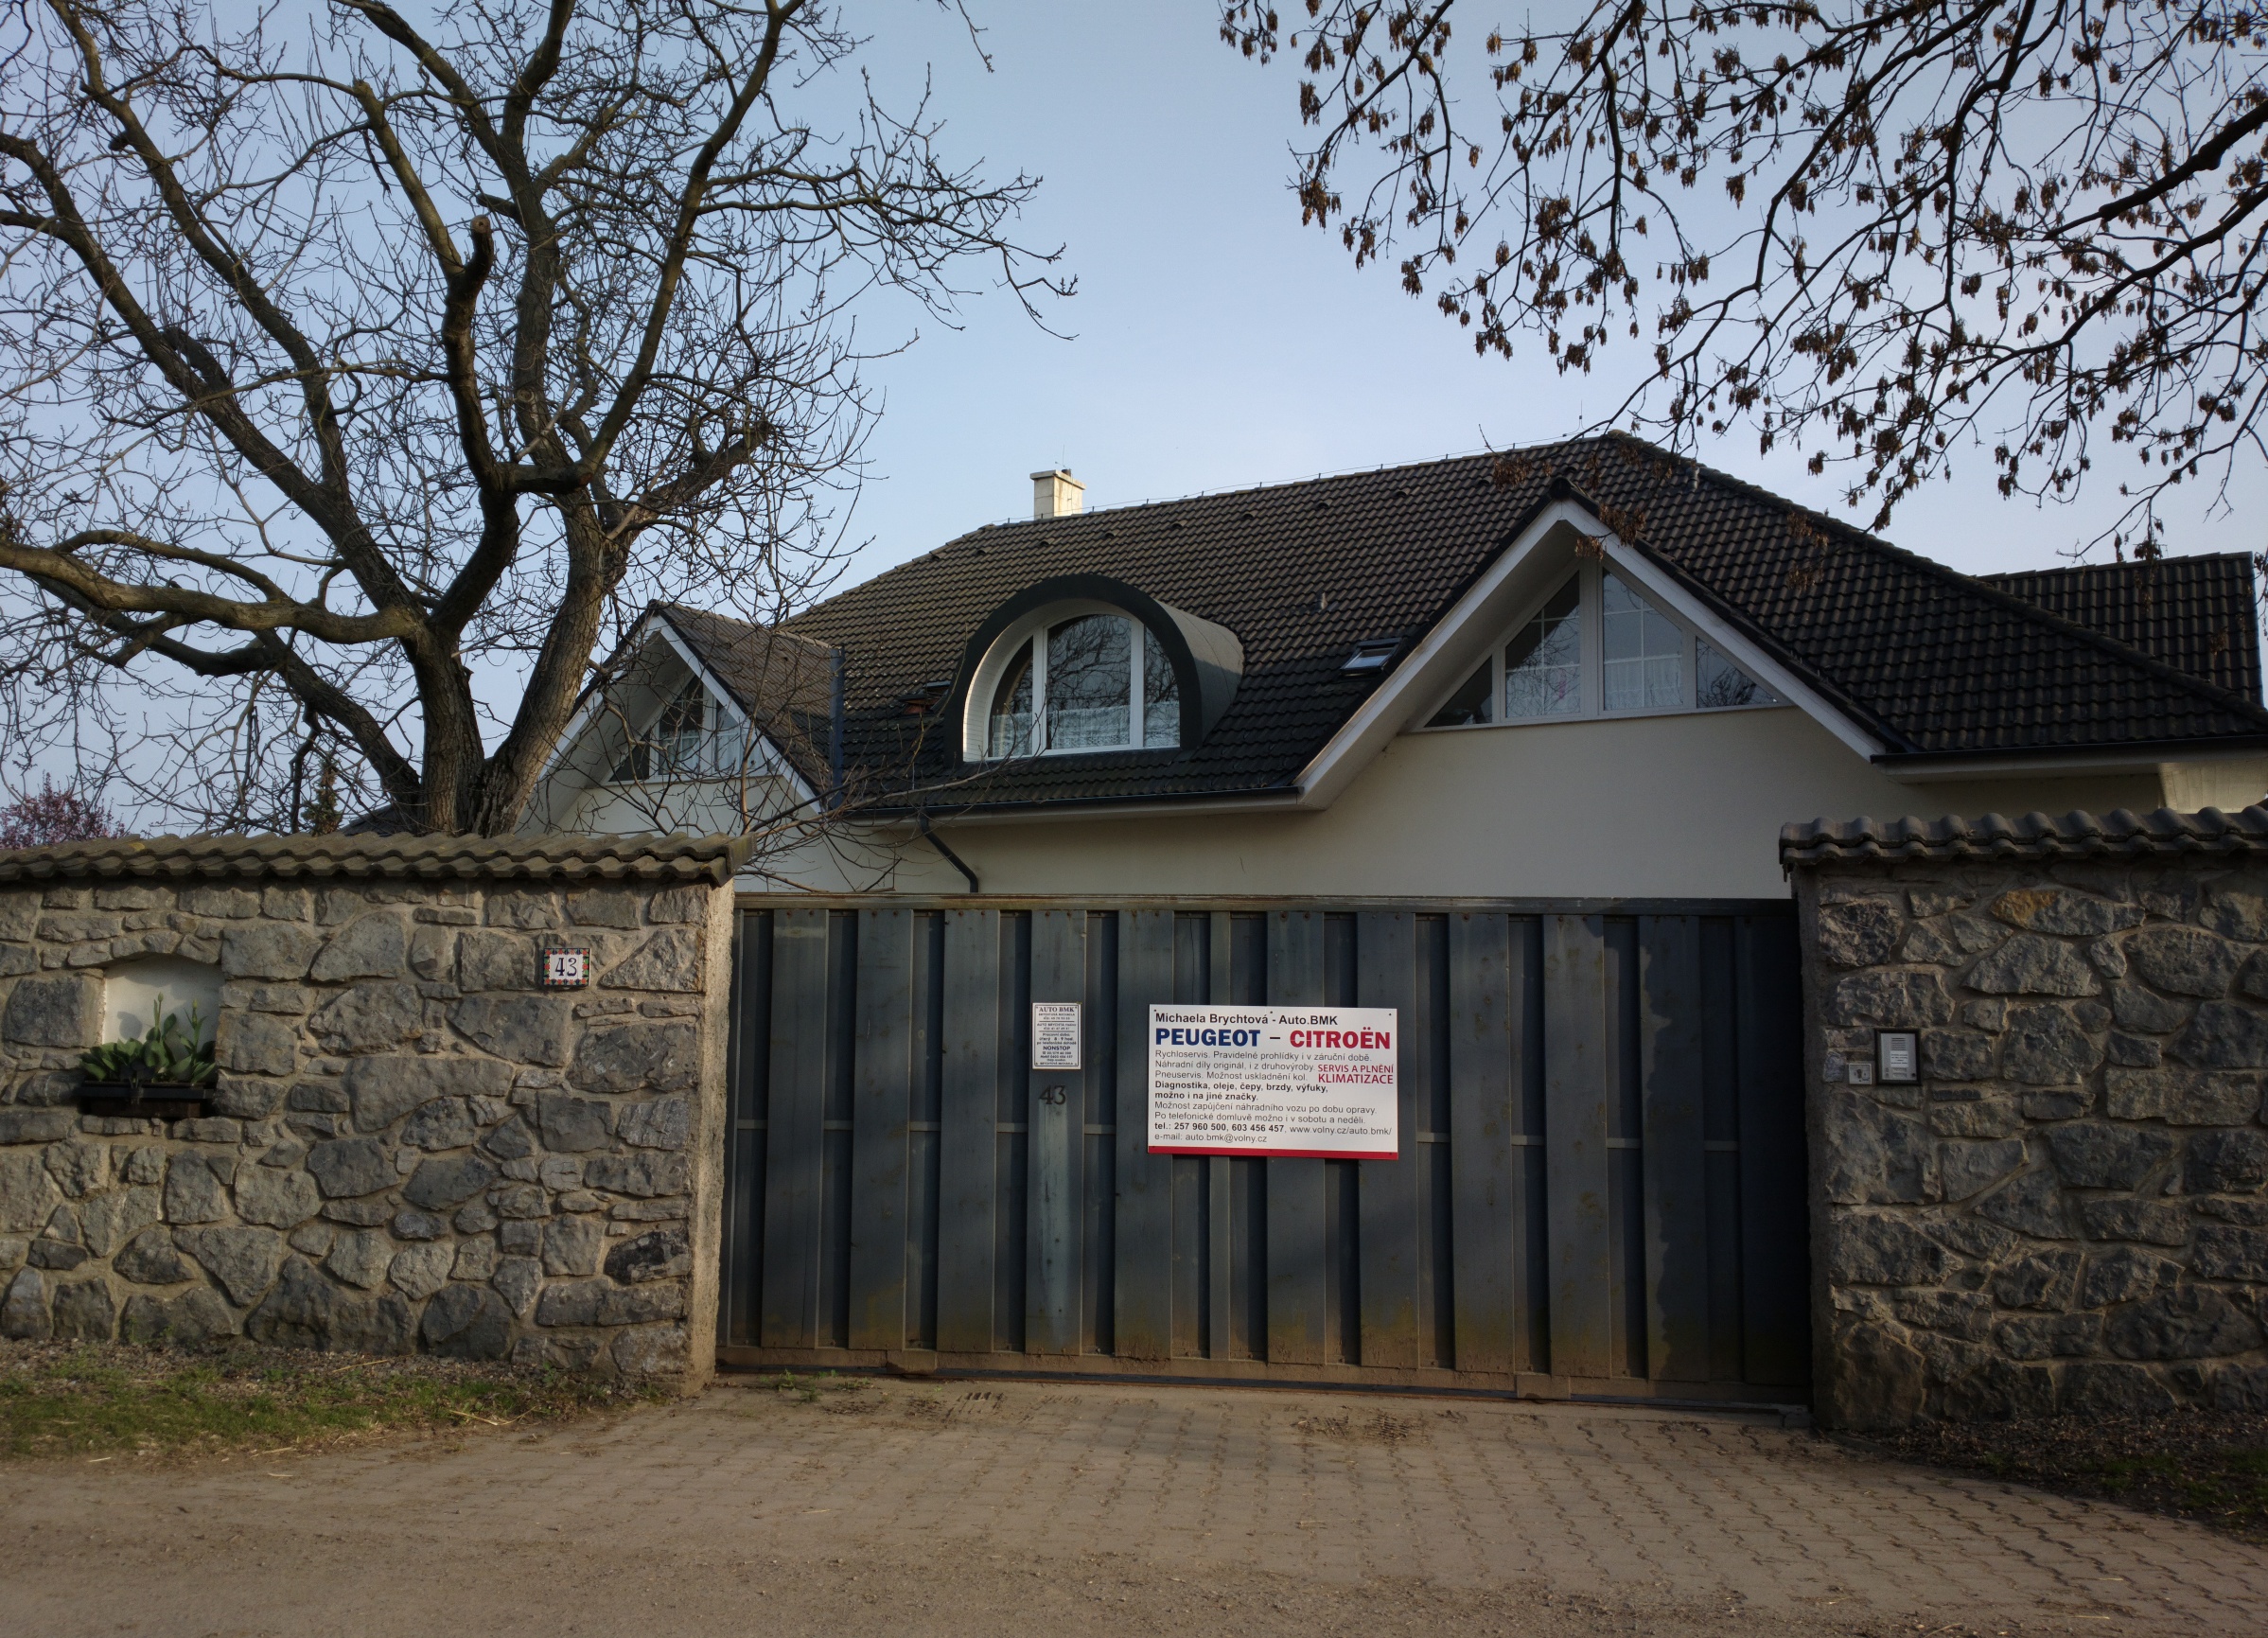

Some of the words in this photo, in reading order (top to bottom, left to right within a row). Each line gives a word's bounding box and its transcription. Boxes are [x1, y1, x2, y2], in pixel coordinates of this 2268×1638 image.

[555, 957, 577, 976] 43
[1156, 1013, 1206, 1023] Michaela
[1210, 1014, 1268, 1025] Brychtová
[1279, 1015, 1338, 1025] Auto.BMK
[1156, 1028, 1261, 1047] PEUGEOT
[1290, 1027, 1390, 1049] CITROËN
[1155, 1050, 1210, 1059] Rychloservis.
[1214, 1051, 1258, 1059] Pravidelné
[1261, 1052, 1299, 1061] prohlídky
[1196, 1061, 1211, 1070] díly
[1214, 1062, 1247, 1070] originál,
[1262, 1062, 1315, 1071] druhovýroby.
[1360, 1064, 1394, 1073] PLNĚNÍ
[1207, 1071, 1242, 1079] Možnost
[1245, 1072, 1291, 1080] uskladnění
[1319, 1074, 1394, 1084] KLIMATIZACE
[1155, 1081, 1211, 1090] Diagnostika,
[1213, 1082, 1237, 1091] oleje,
[1240, 1083, 1263, 1091] čepy,
[1267, 1083, 1293, 1092] brzdy,
[1296, 1084, 1328, 1093] výfuky,
[1039, 1085, 1066, 1105] 43
[1206, 1093, 1222, 1101] jiné
[1225, 1093, 1258, 1102] značky.
[1155, 1101, 1191, 1110] Možnost
[1193, 1102, 1232, 1111] zapůjčení
[1346, 1107, 1377, 1115] opravy.
[1216, 1113, 1252, 1121] domluvě
[1211, 1123, 1229, 1131] 500,
[1269, 1125, 1286, 1133] 457,
[1289, 1127, 1392, 1136] www.volny.cz/auto.bmk/
[1185, 1134, 1267, 1143] auto.bmk@volny.cz
